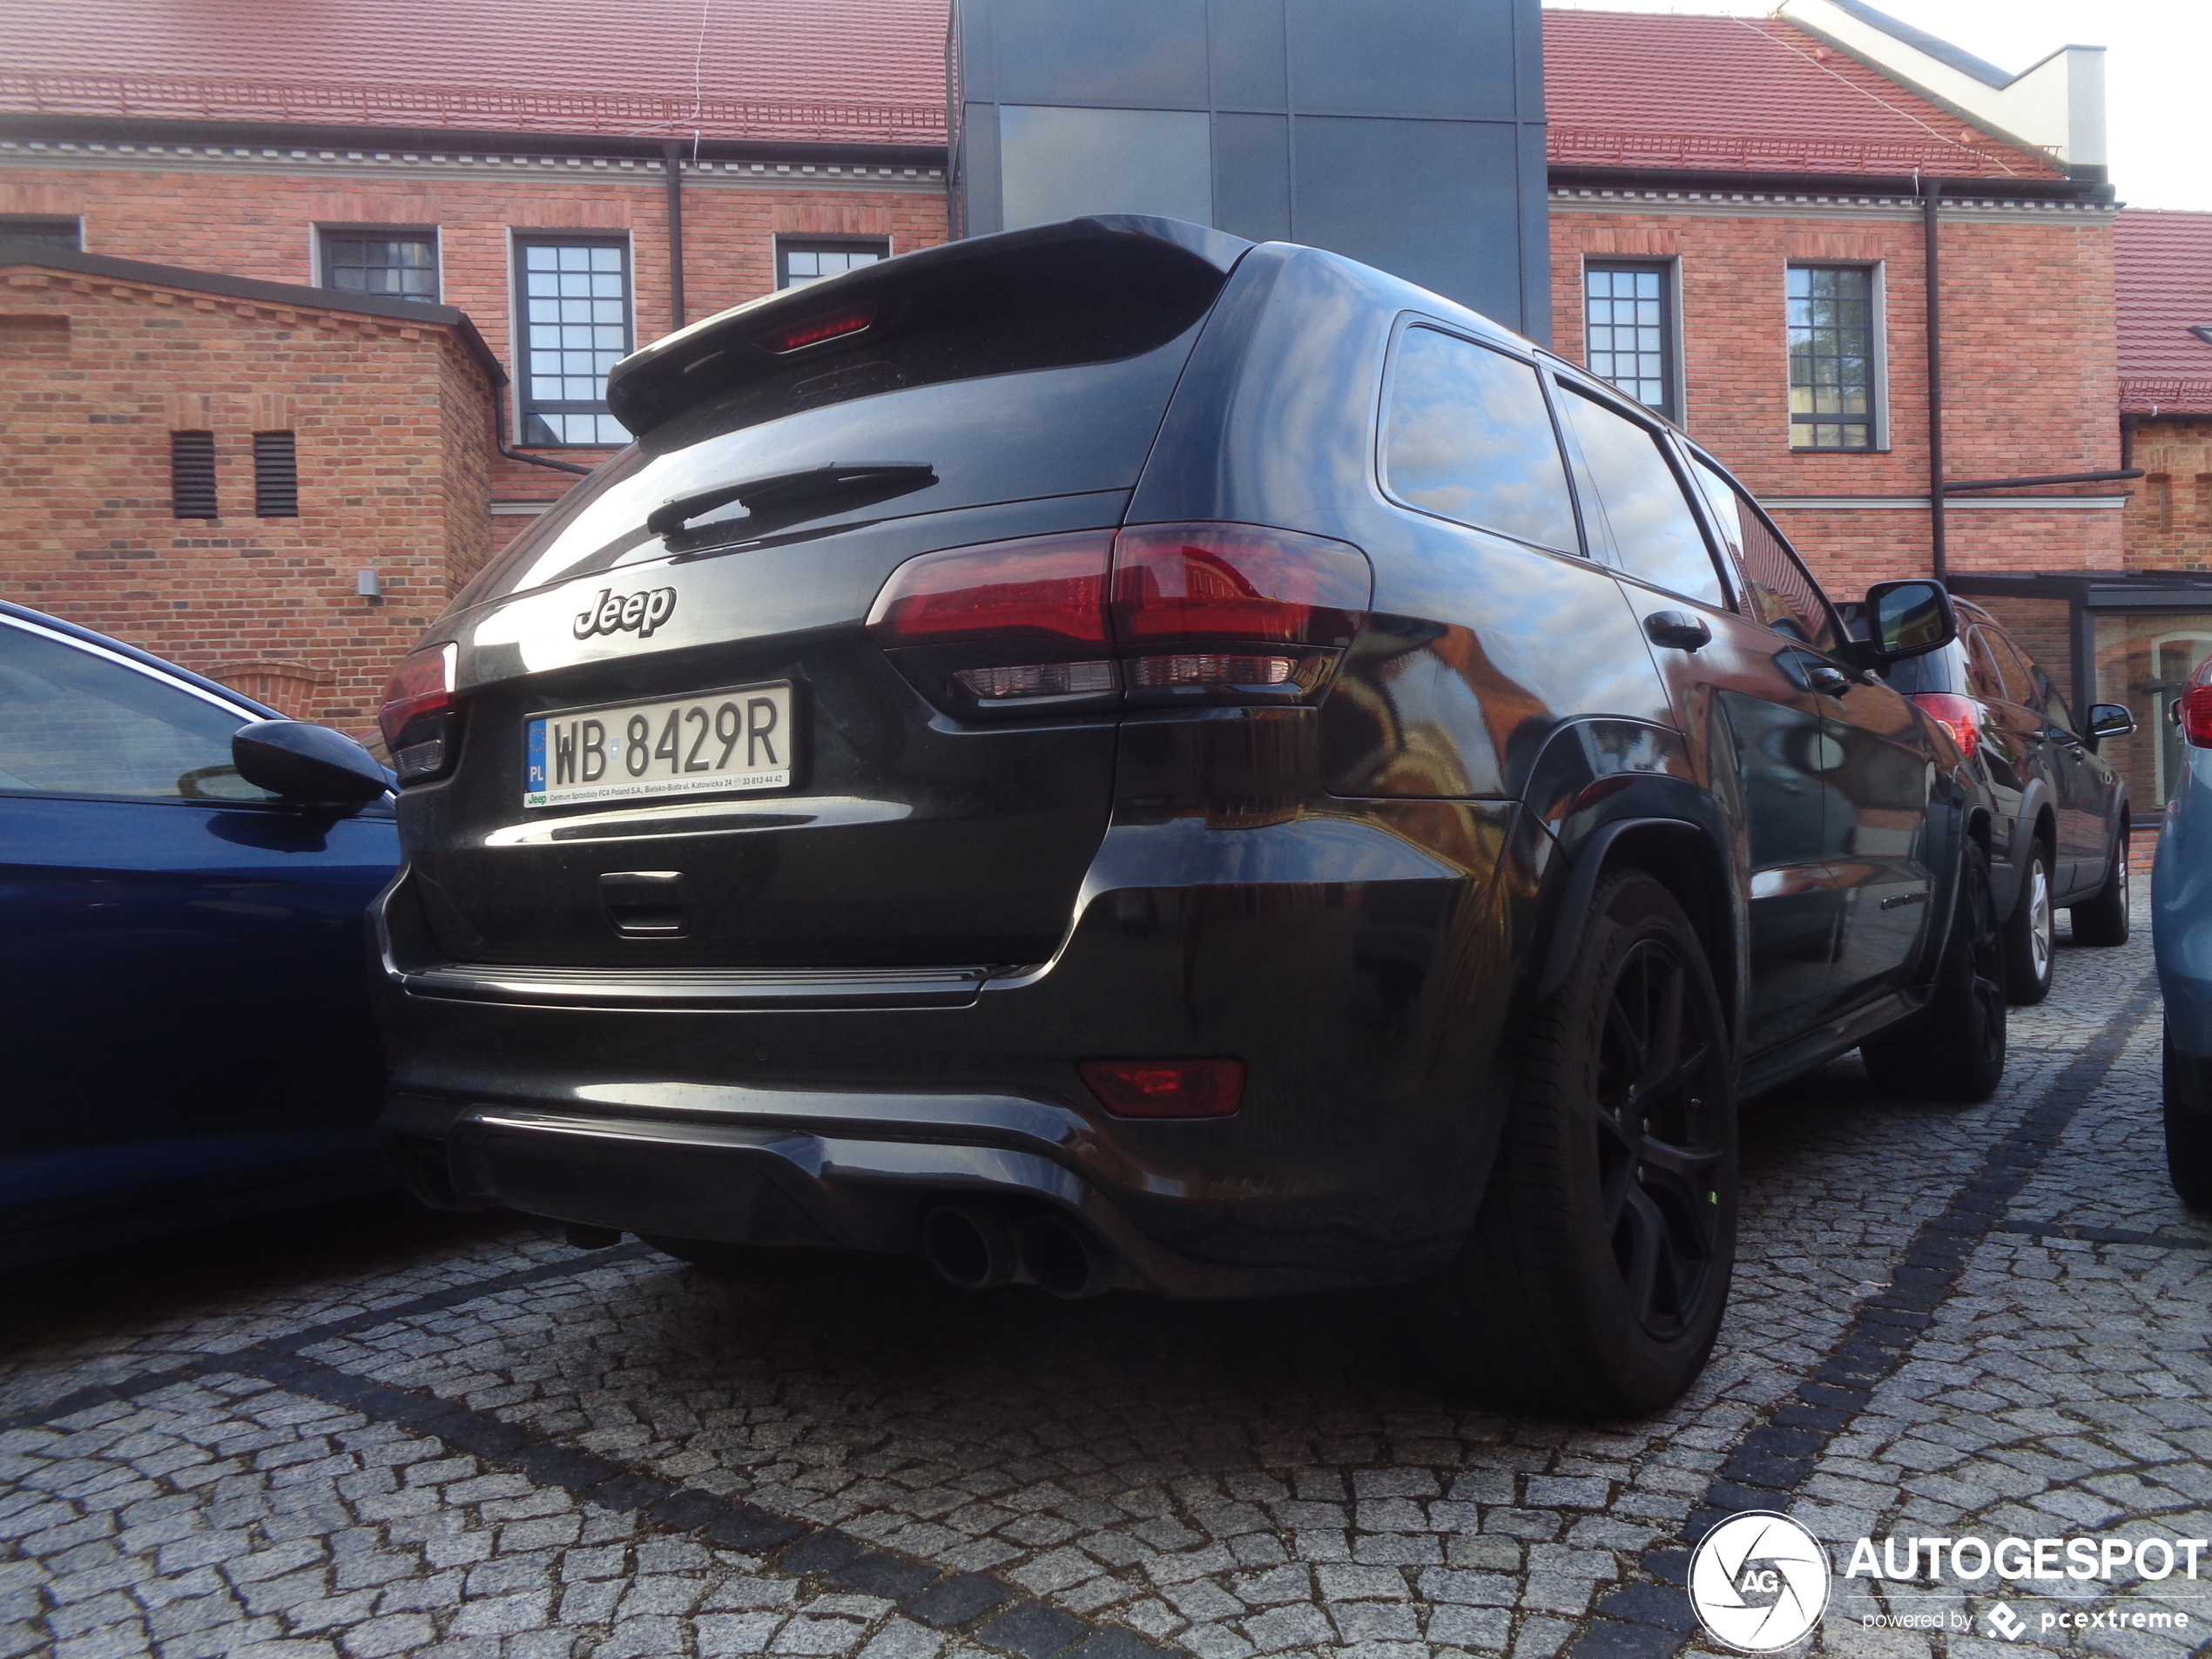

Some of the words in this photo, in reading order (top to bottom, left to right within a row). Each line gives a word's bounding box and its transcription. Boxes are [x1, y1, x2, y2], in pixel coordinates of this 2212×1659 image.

[573, 587, 677, 640] Jeep
[554, 718, 607, 785] WB
[625, 697, 778, 777] 8429R
[529, 765, 544, 782] PL
[528, 793, 547, 805] Jeep
[550, 793, 571, 802] Centrum
[598, 788, 610, 797] FCA
[611, 787, 631, 796] Poland
[691, 780, 724, 789] Katowicka
[752, 776, 764, 785] 813
[774, 774, 783, 783] 42
